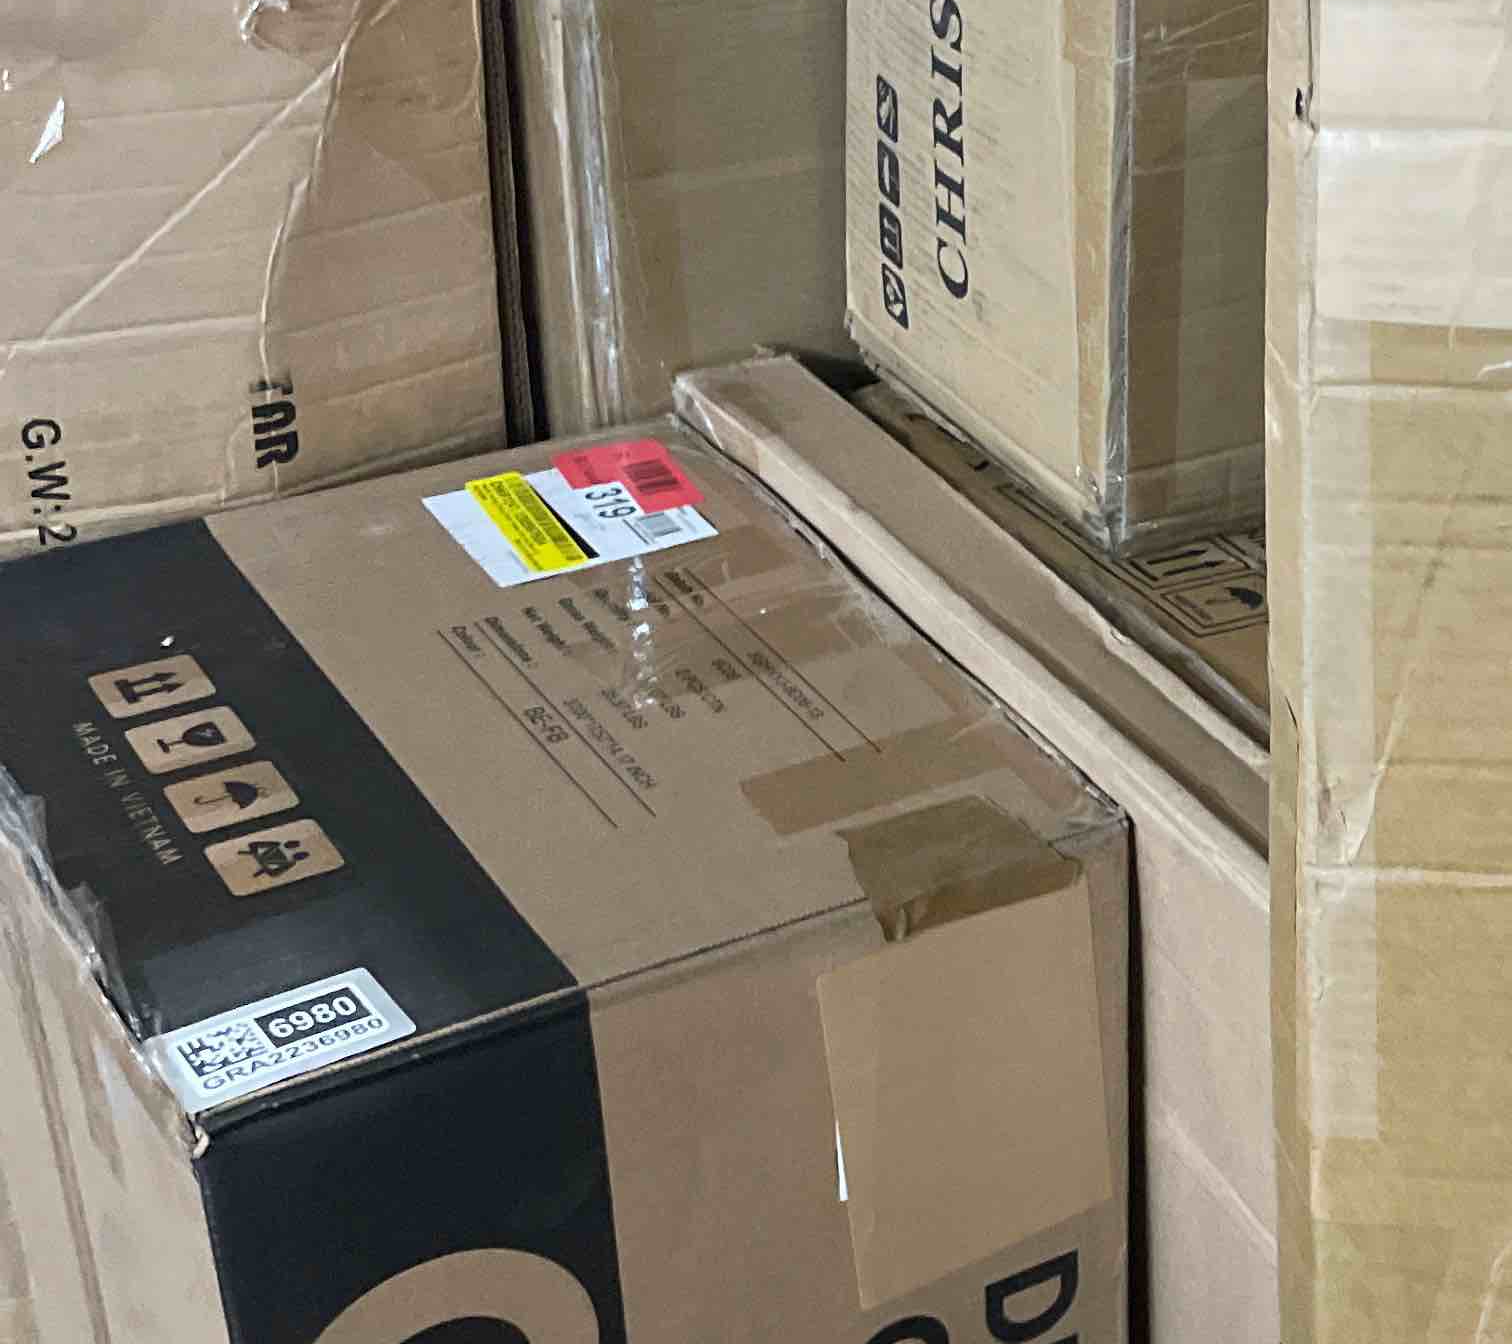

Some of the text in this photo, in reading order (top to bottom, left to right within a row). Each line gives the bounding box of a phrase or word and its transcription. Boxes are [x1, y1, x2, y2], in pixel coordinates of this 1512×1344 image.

[585, 487, 636, 519] 319
[72, 721, 184, 865] MADE IN VIETNAM
[268, 996, 357, 1038] 6980
[203, 1017, 384, 1090] GRA2236980
